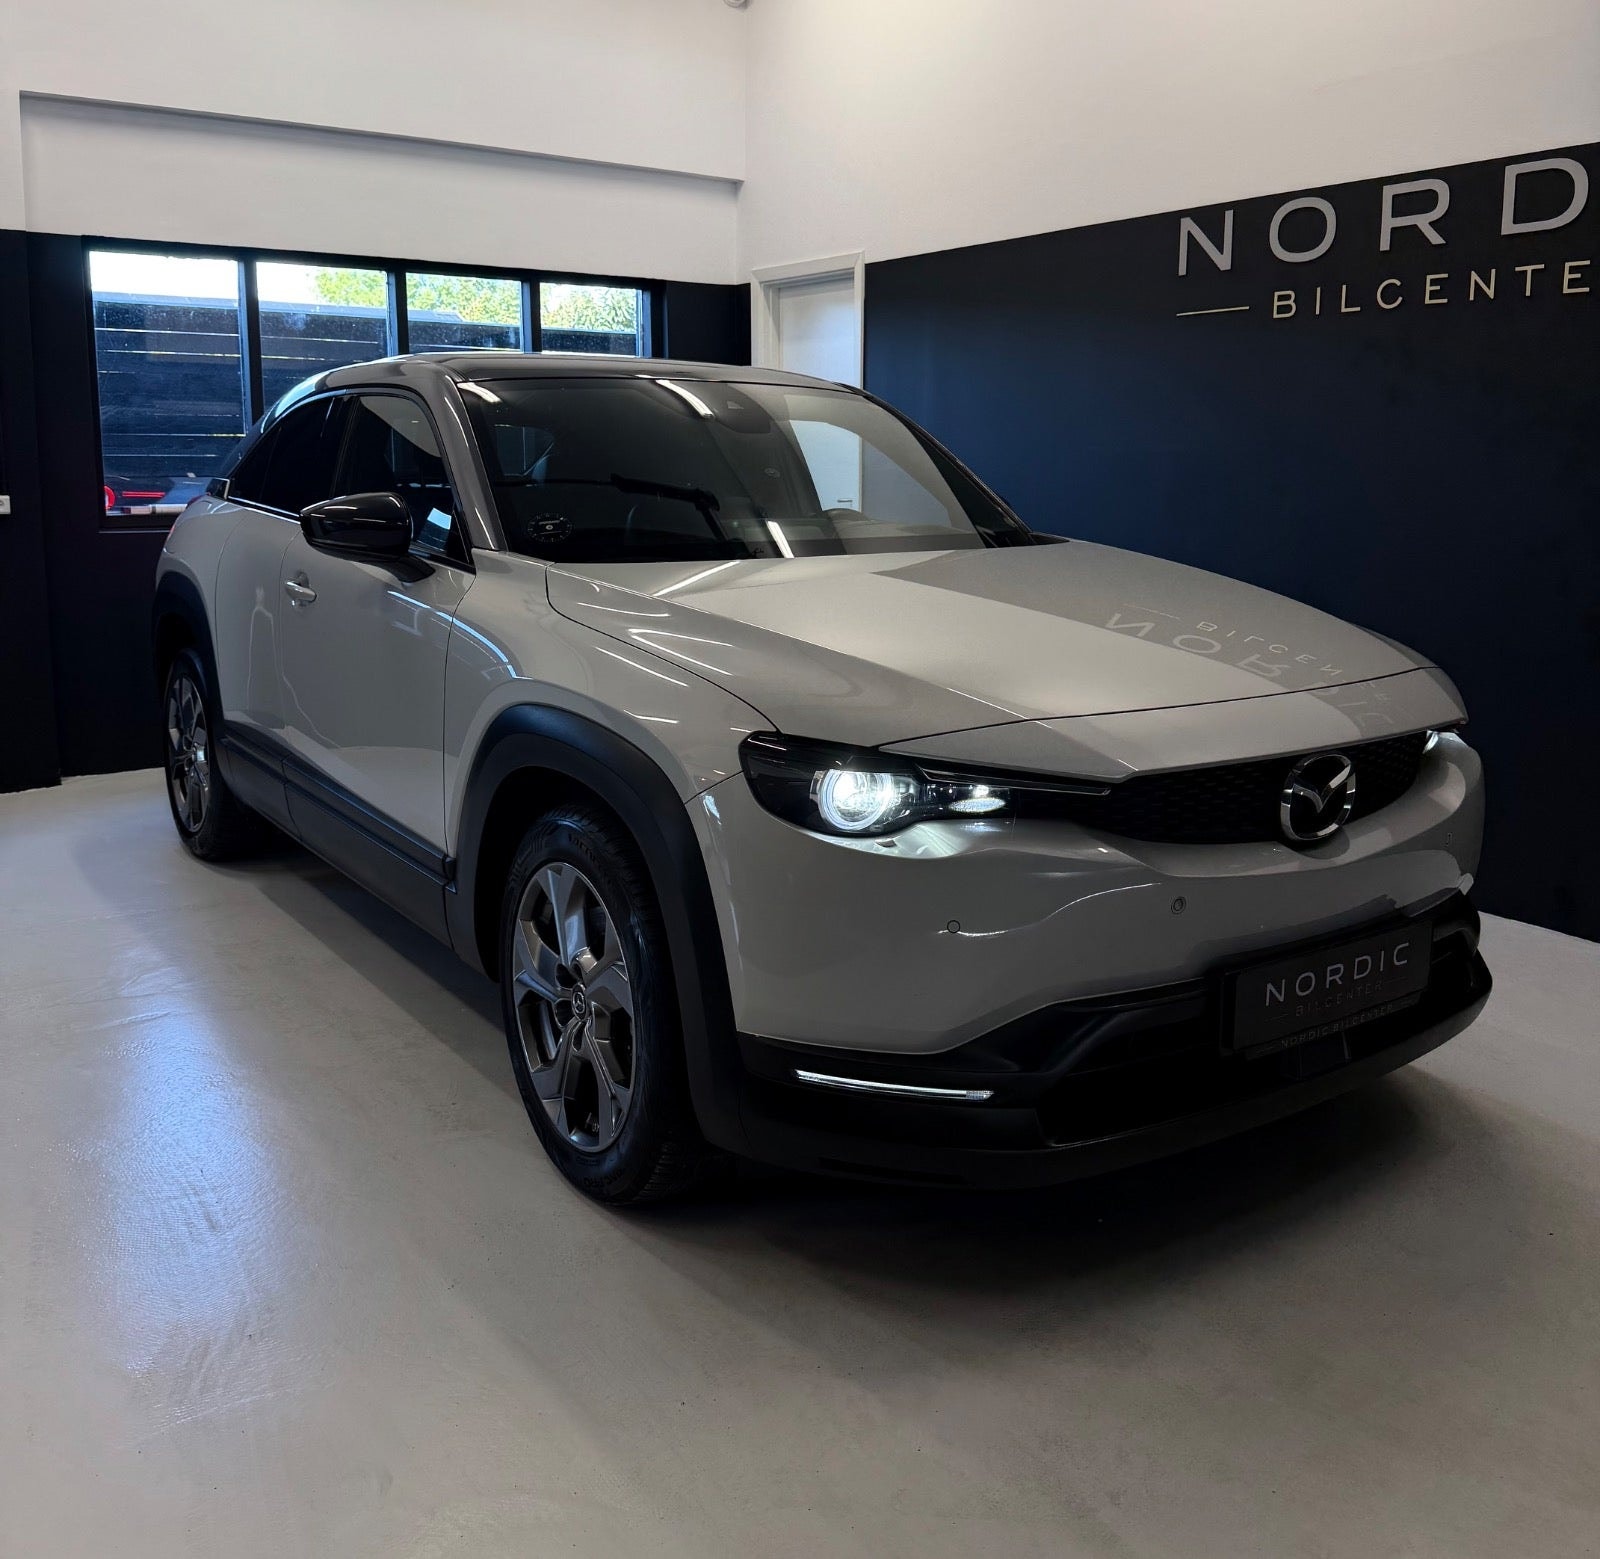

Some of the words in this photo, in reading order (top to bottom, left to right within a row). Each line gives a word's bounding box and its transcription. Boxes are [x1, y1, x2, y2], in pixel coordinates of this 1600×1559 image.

[1178, 157, 1590, 276] NORD
[1272, 259, 1591, 319] BILCENTE
[1265, 942, 1410, 1007] NORDIC
[1295, 981, 1383, 1017] BILCENTER
[1281, 1026, 1329, 1049] NORDIC
